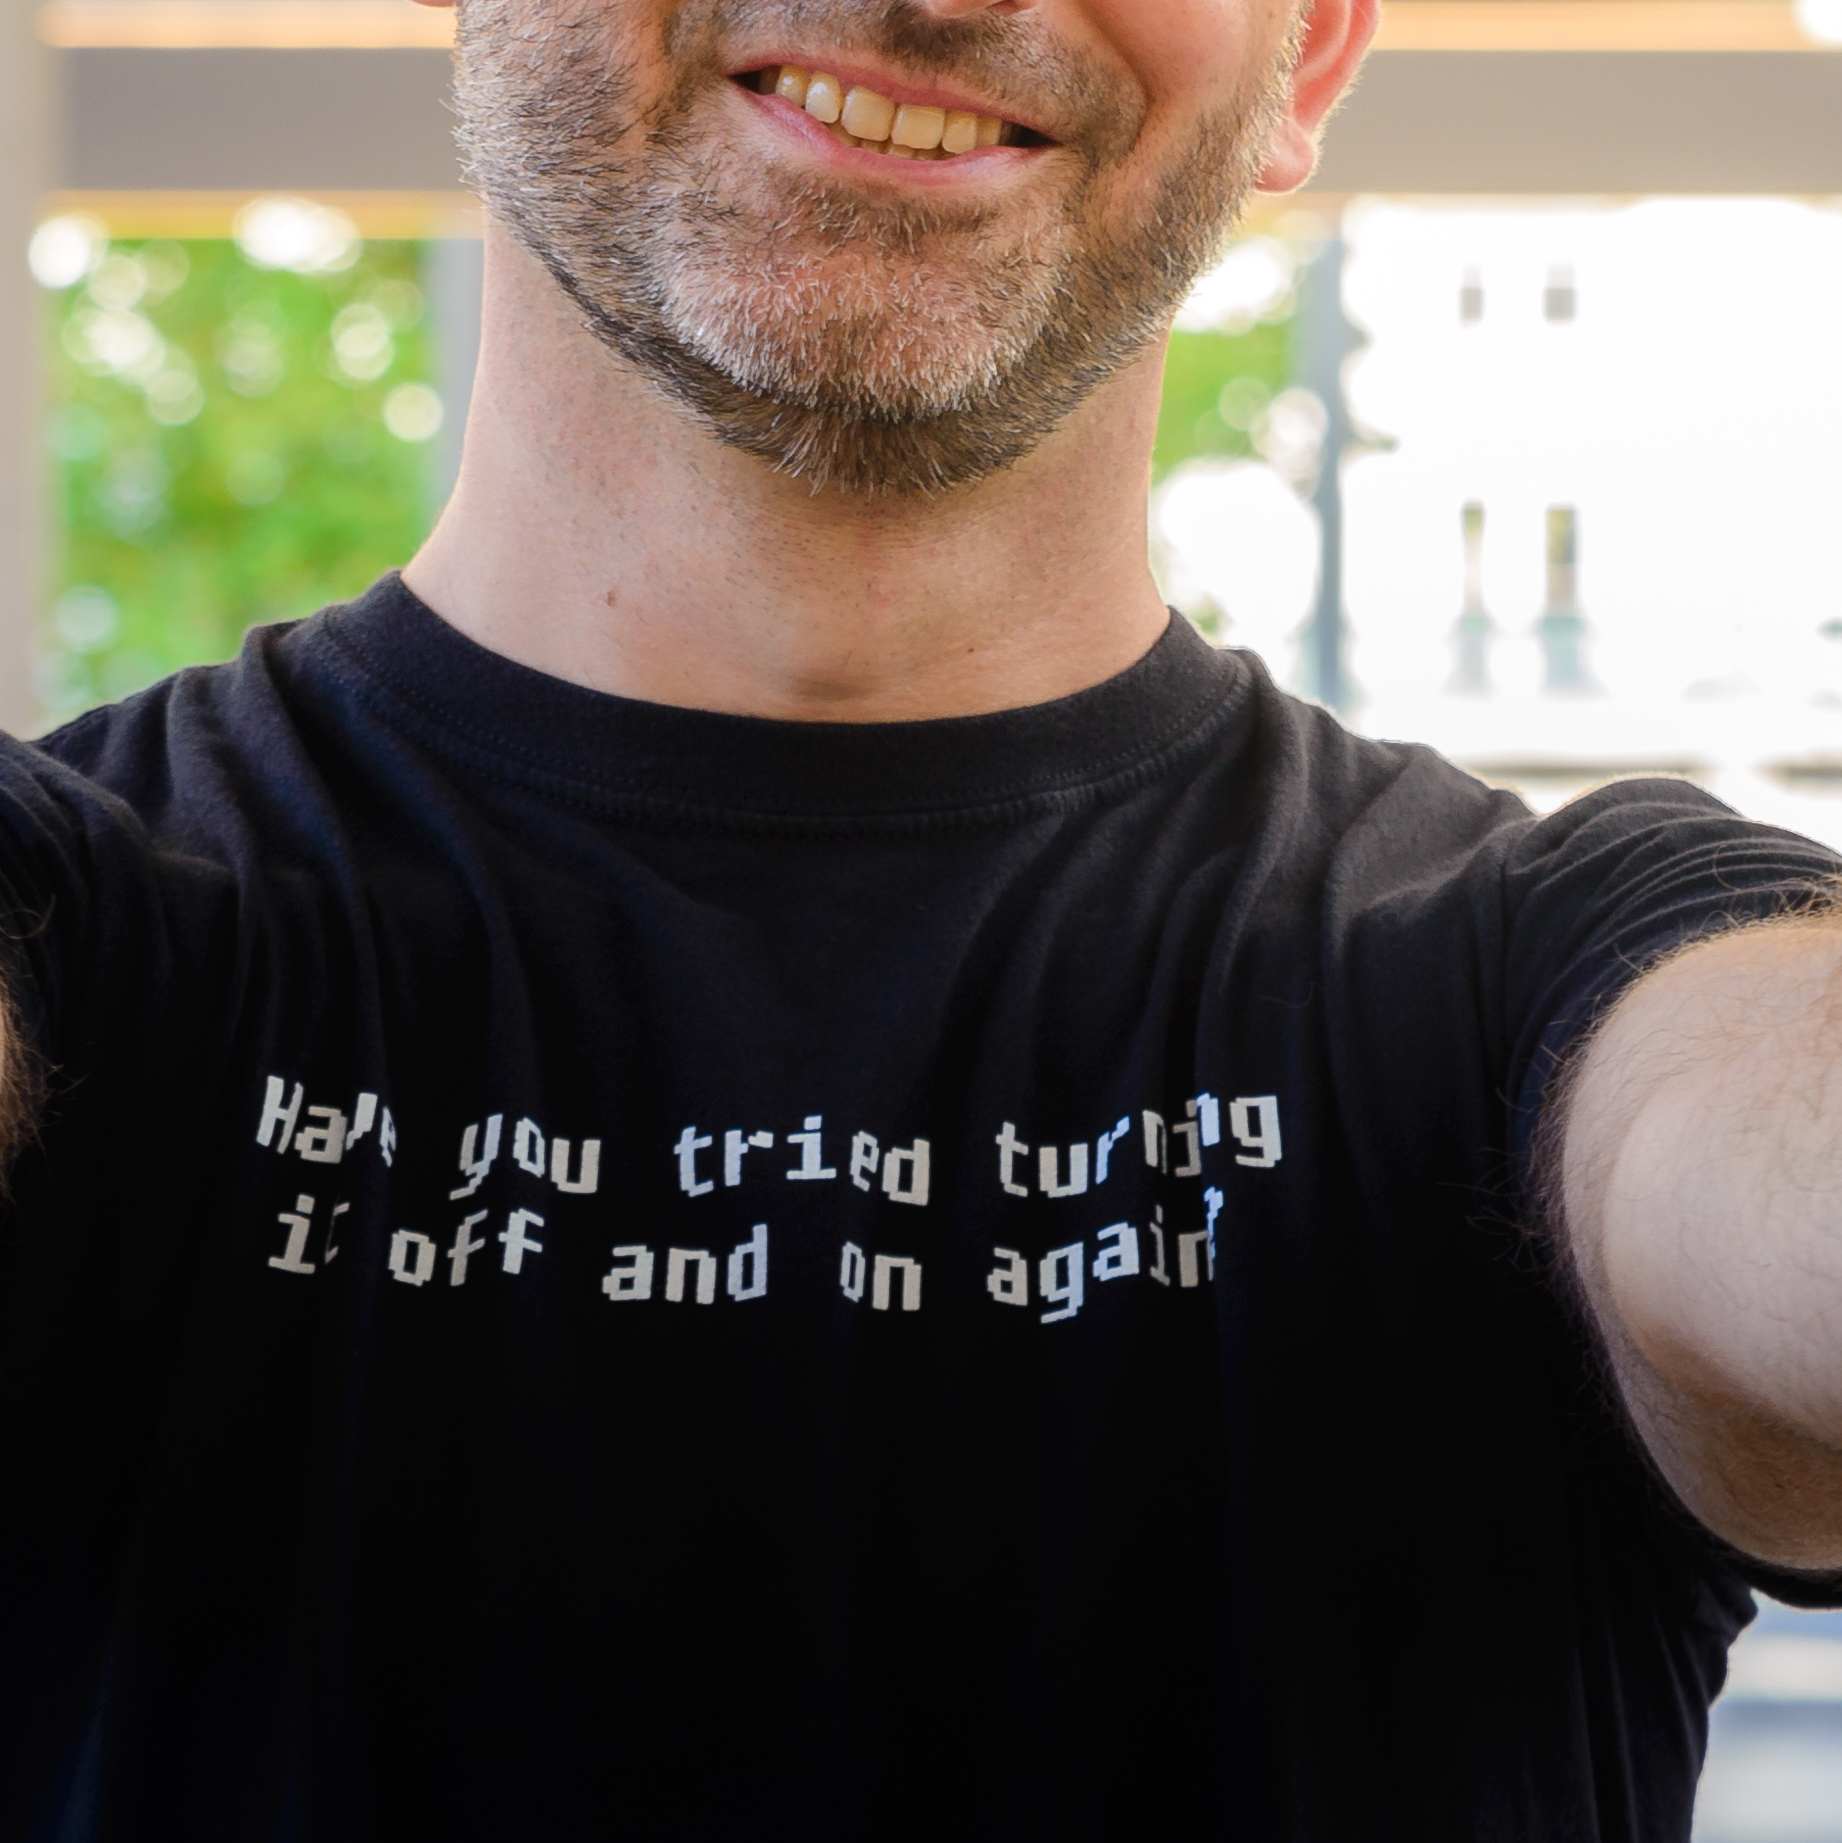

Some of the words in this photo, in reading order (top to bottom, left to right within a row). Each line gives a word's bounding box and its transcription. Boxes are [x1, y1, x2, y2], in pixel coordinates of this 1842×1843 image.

[448, 1113, 602, 1202] you
[673, 1114, 931, 1206] tried
[387, 1207, 545, 1287] off
[601, 1223, 768, 1305] and
[839, 1241, 922, 1311] on
